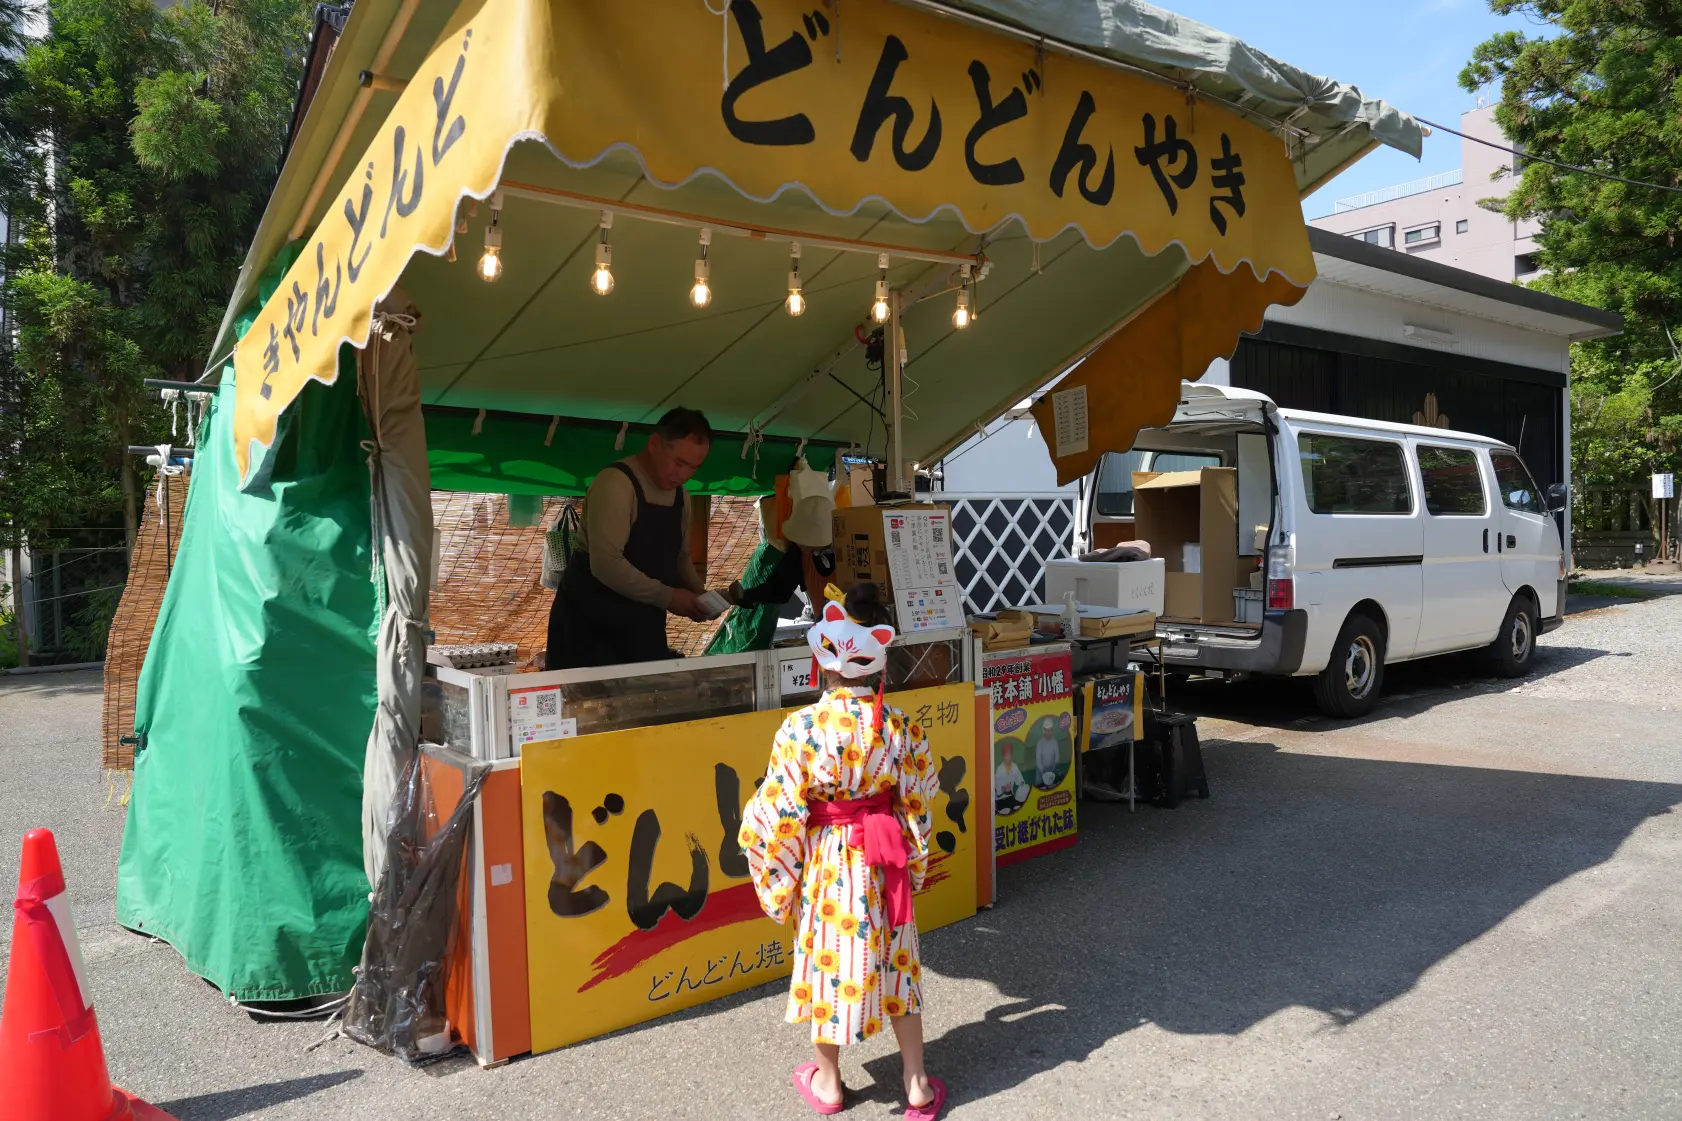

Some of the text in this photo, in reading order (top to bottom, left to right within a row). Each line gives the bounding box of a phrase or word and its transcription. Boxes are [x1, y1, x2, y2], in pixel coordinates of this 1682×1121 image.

[721, 0, 1246, 236] どんどんやき
[915, 700, 959, 729] 名物
[995, 807, 1074, 852] 受け継がれた味
[648, 939, 795, 1001] どんどん焼
